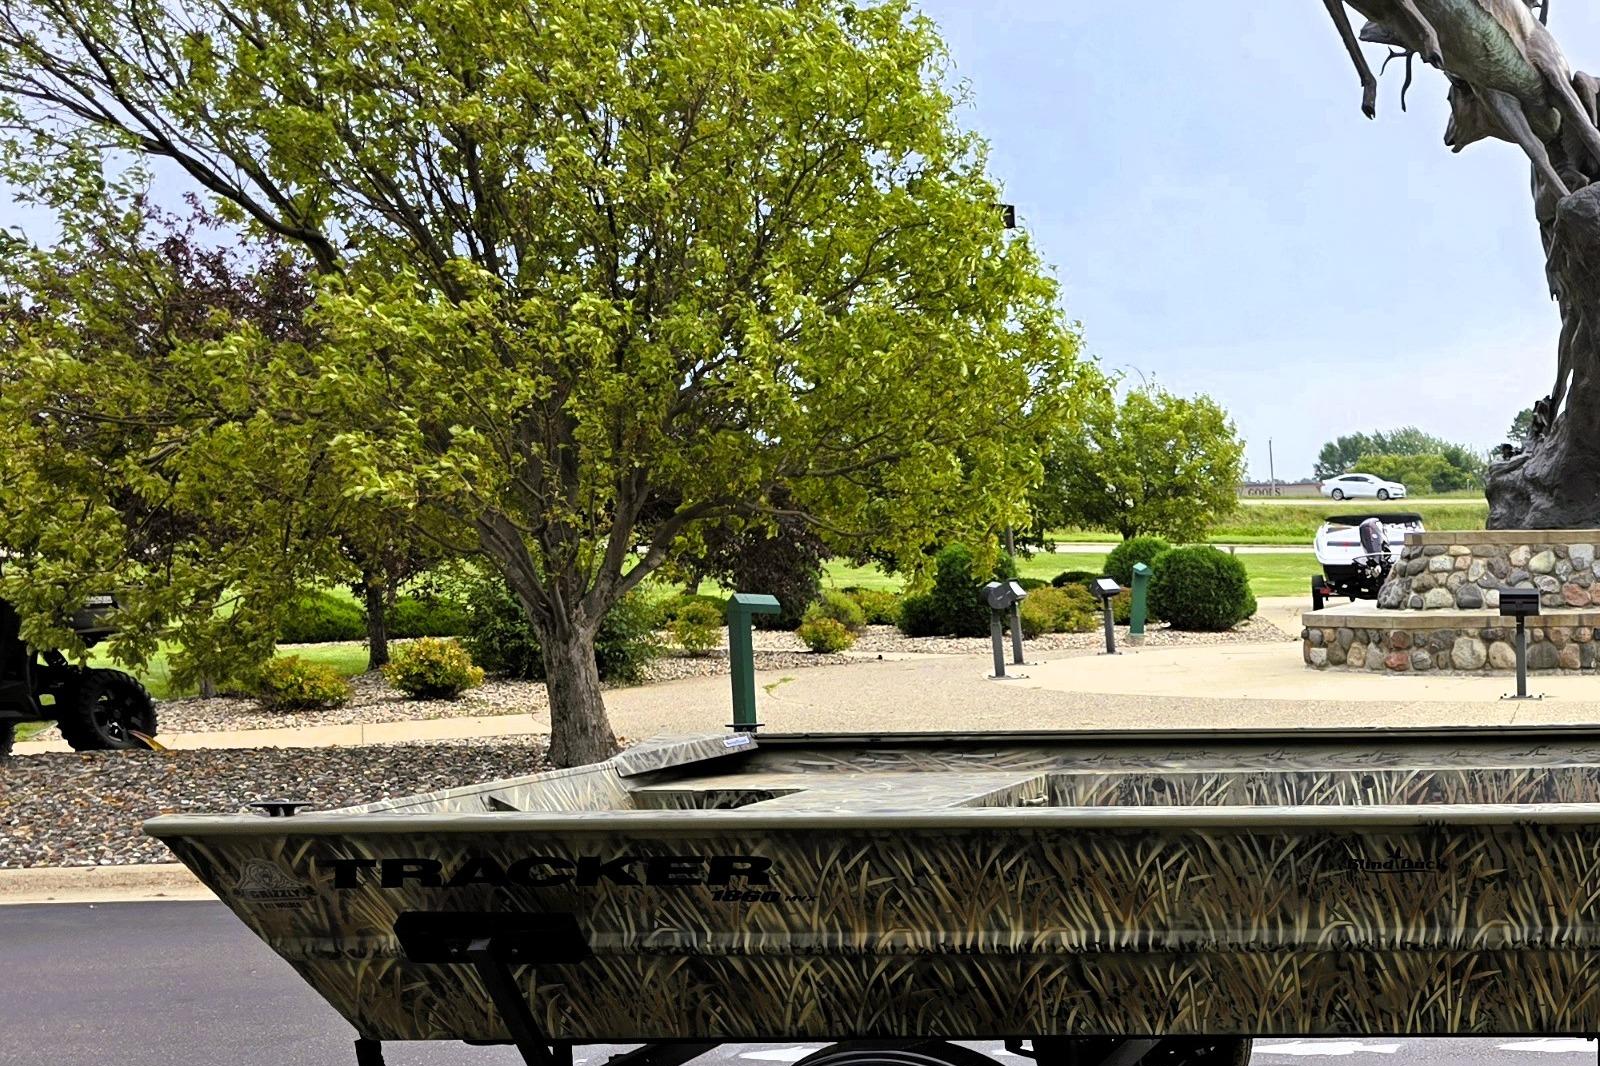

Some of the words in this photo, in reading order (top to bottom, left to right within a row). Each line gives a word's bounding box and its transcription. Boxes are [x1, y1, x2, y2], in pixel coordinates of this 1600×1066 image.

[317, 855, 775, 888] TRACKER
[250, 889, 300, 899] GRIZZLY
[710, 890, 780, 902] 1860
